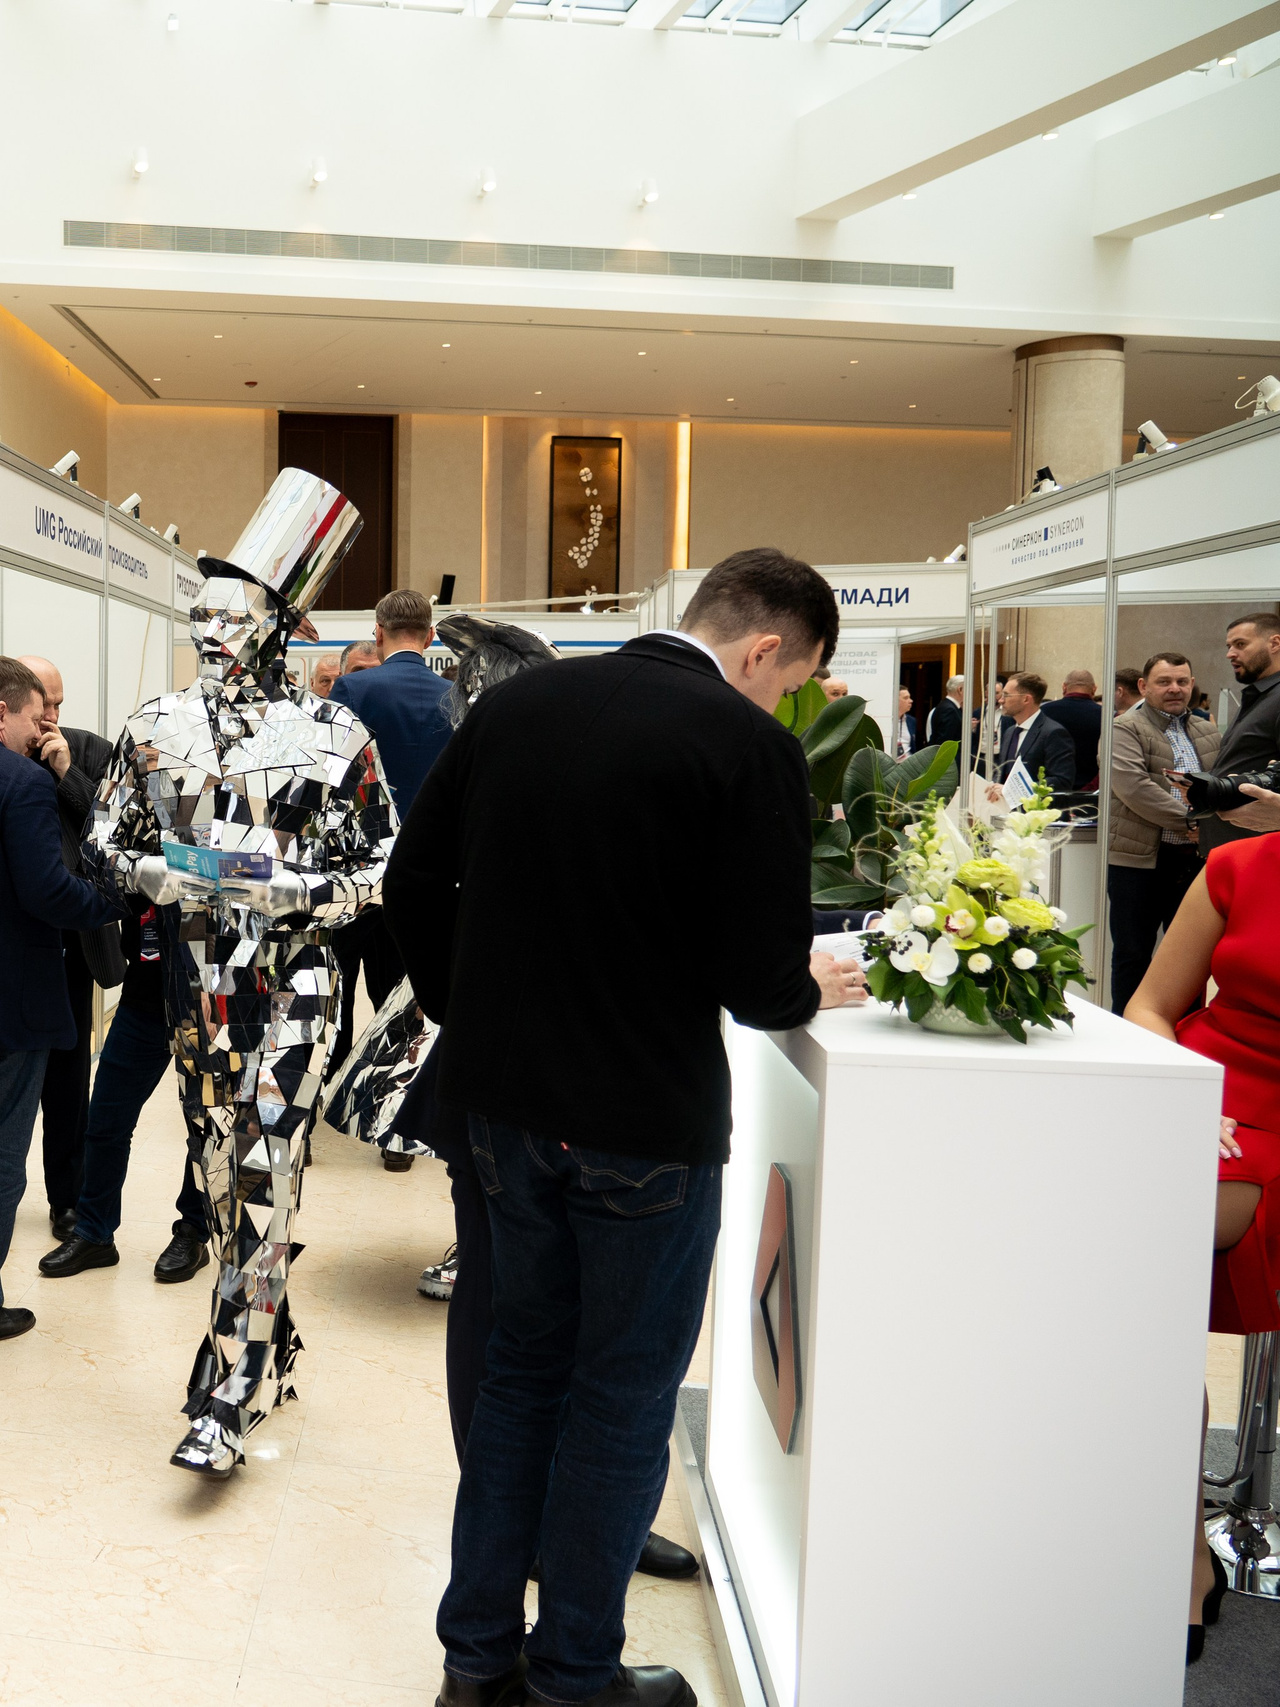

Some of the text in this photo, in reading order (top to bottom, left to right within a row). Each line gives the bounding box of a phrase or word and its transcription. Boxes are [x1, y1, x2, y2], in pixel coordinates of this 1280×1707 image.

[34, 505, 56, 541] UMG
[58, 516, 103, 560] Российский
[1011, 515, 1085, 551] СИНЕРКОН SYNERCON
